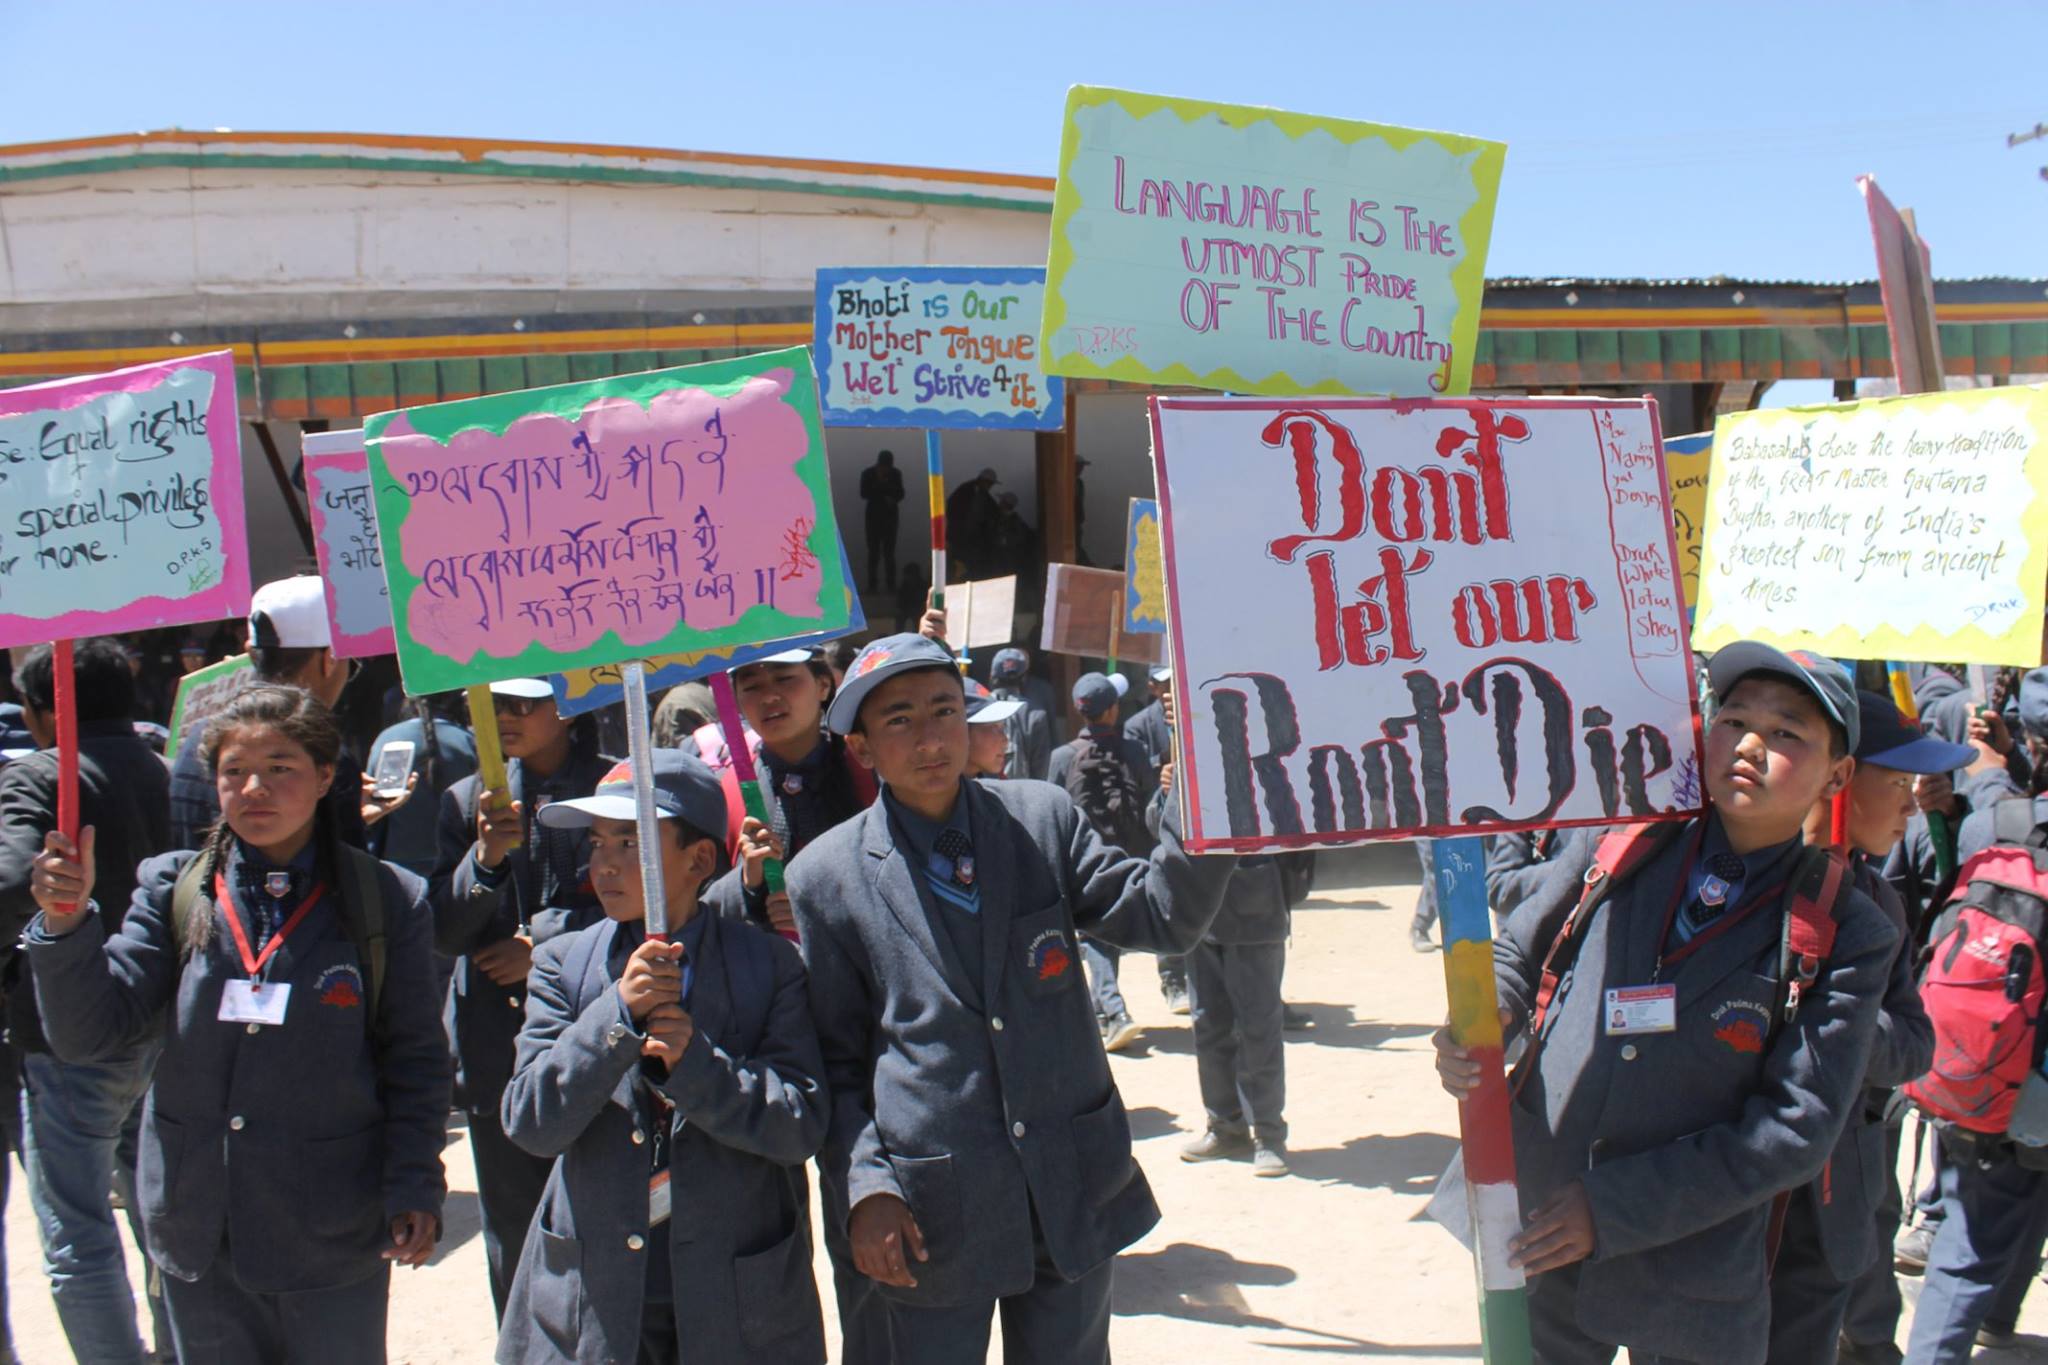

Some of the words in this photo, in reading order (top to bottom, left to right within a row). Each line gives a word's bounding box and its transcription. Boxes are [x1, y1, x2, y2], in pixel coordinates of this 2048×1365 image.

[1114, 155, 1323, 238] LANGUAGE
[1348, 198, 1386, 247] IS
[1394, 205, 1456, 257] THE
[837, 282, 910, 319] Bhoti
[962, 290, 1019, 320] Our
[1181, 236, 1325, 288] UTMOST
[836, 321, 931, 361] Mother
[940, 326, 1035, 364] Tongue
[1180, 277, 1240, 333] OF
[1256, 286, 1331, 345] THE
[1340, 297, 1453, 393] Country
[914, 363, 990, 404] Strive
[1010, 372, 1037, 408] it
[40, 421, 118, 480] Equal
[115, 400, 208, 462] rights
[1305, 545, 1435, 671] let
[1451, 574, 1598, 648] our
[1461, 656, 1673, 825] Die
